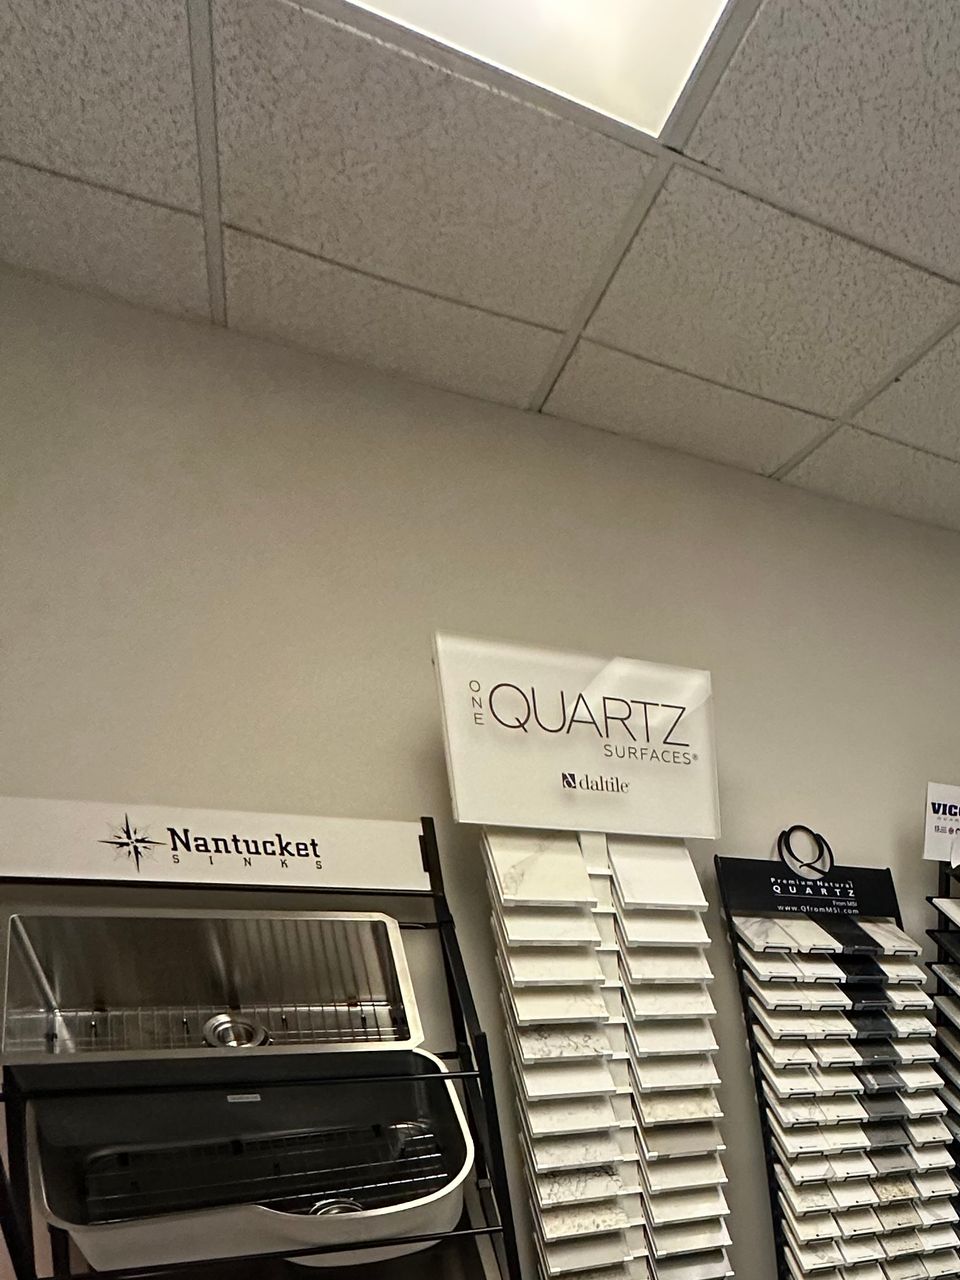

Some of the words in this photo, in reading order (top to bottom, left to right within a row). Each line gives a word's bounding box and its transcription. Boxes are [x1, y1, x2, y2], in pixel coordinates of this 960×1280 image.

[469, 680, 485, 725] ONE
[489, 683, 690, 747] QUARTZ
[579, 774, 630, 794] daltile
[166, 827, 321, 859] Nantucket
[172, 855, 323, 870] SINKS
[770, 877, 814, 886] Premium
[817, 880, 854, 889] Natural
[772, 885, 855, 897] QUARTZ
